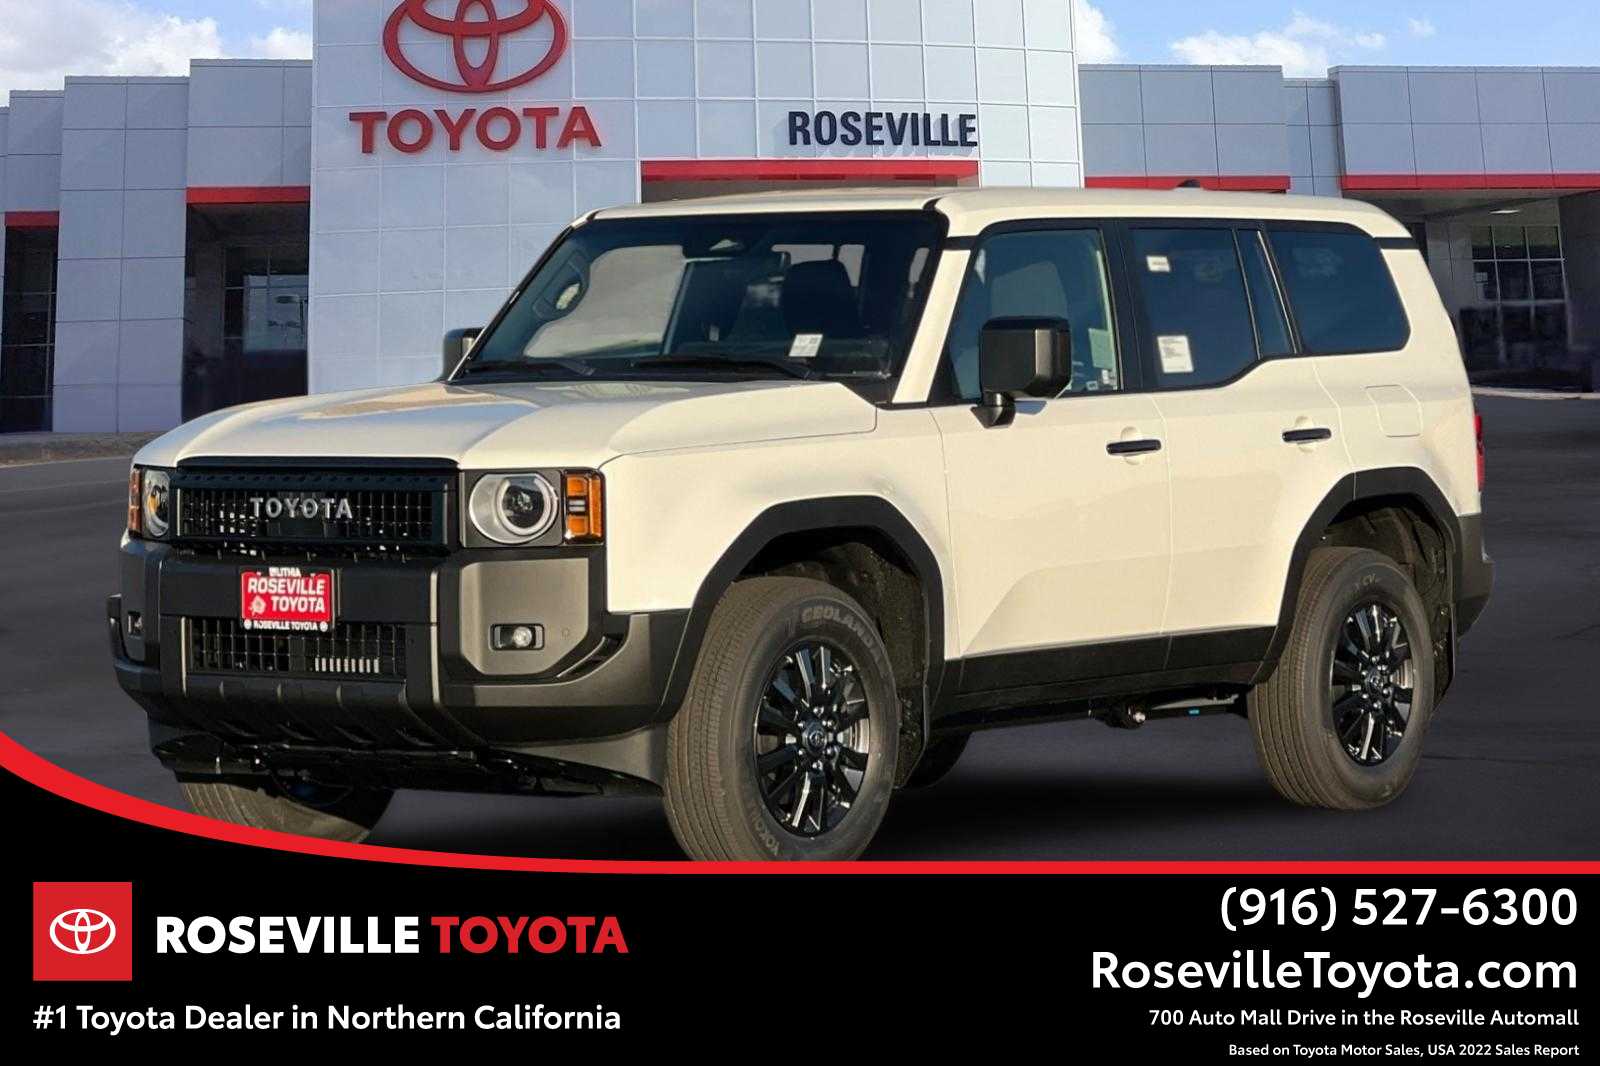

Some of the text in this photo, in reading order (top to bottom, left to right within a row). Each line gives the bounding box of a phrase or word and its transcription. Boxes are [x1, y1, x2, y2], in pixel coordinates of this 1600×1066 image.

[349, 106, 602, 154] TOYOTA
[788, 111, 978, 147] ROSEVILLE
[250, 497, 352, 519] TOYOTA
[247, 578, 325, 596] ROSEVILLE
[270, 595, 325, 613] TOYOTA
[291, 622, 319, 631] TOYOTA
